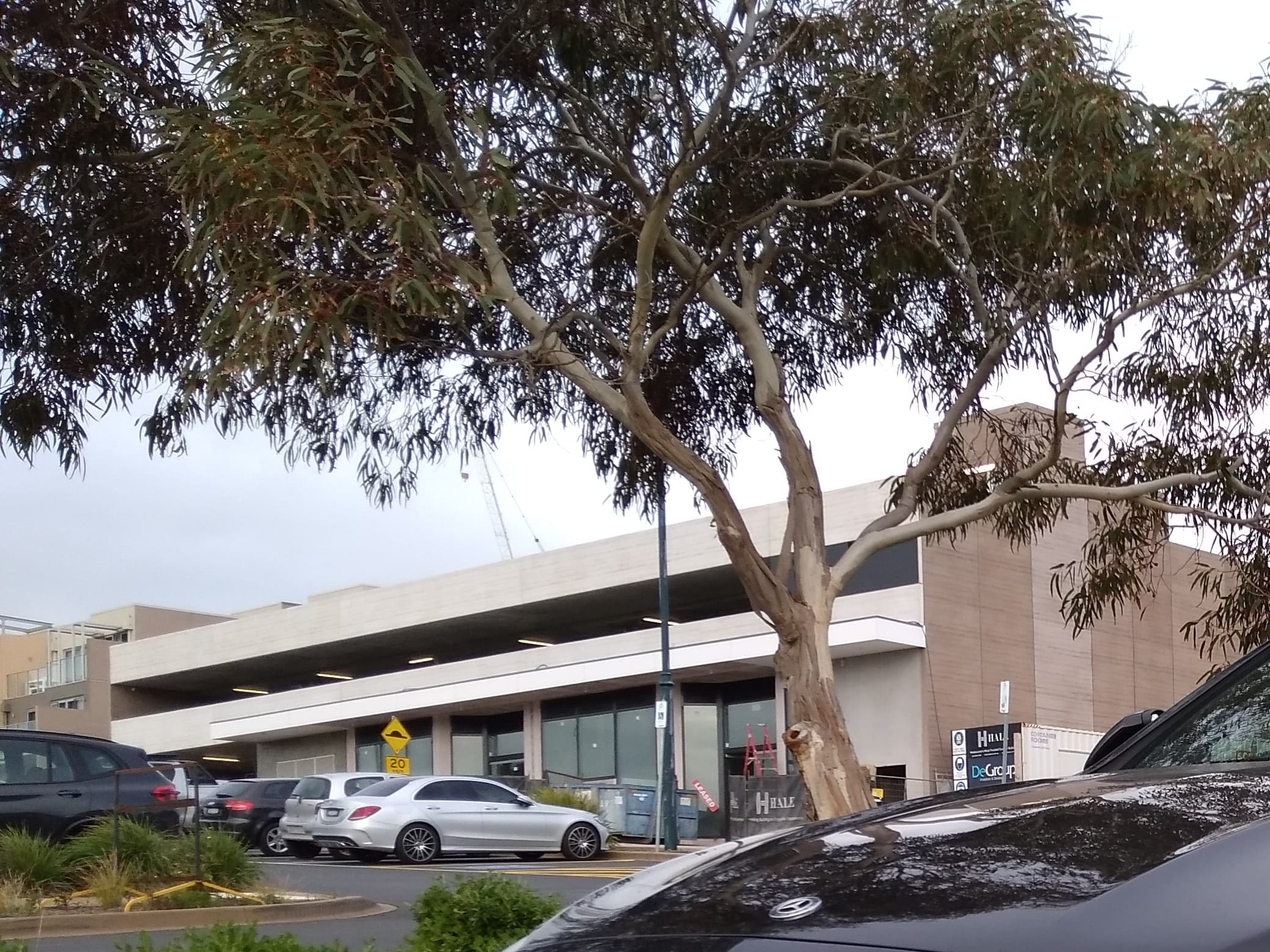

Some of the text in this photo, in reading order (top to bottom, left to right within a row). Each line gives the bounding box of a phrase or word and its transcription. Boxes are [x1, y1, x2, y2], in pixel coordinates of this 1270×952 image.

[988, 732, 1010, 743] HAL
[390, 758, 406, 769] 20
[694, 781, 716, 808] LEASED
[770, 796, 796, 809] HALE
